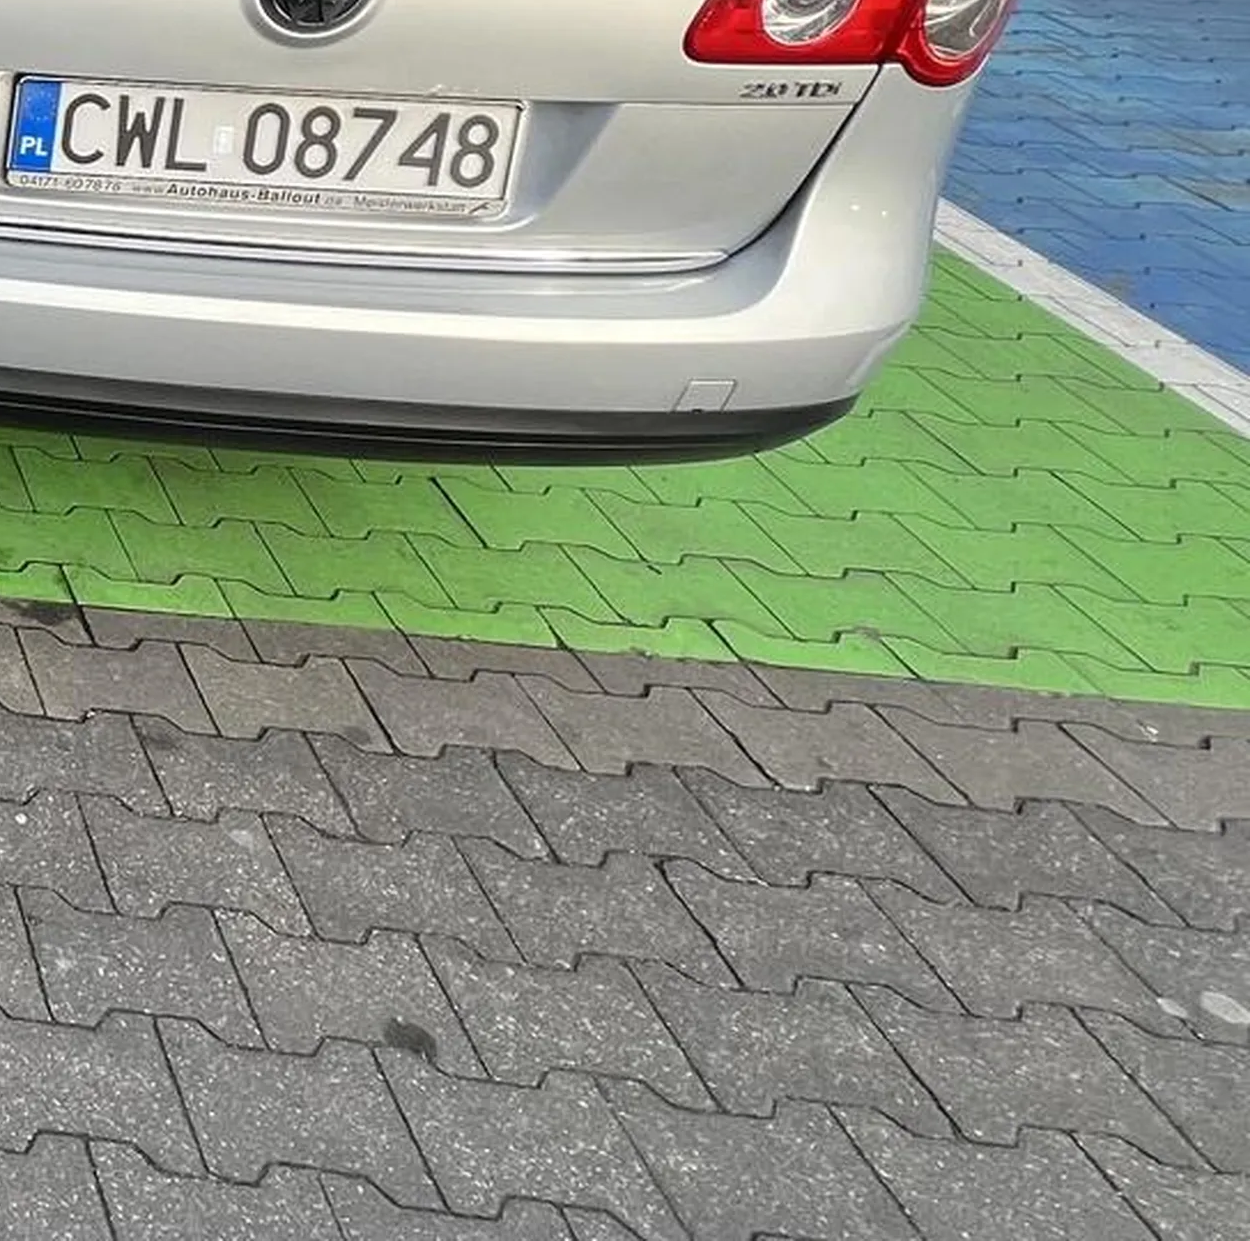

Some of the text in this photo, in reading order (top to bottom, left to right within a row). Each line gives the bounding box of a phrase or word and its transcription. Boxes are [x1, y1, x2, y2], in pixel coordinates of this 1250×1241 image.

[19, 92, 502, 189] PL CWL 08748
